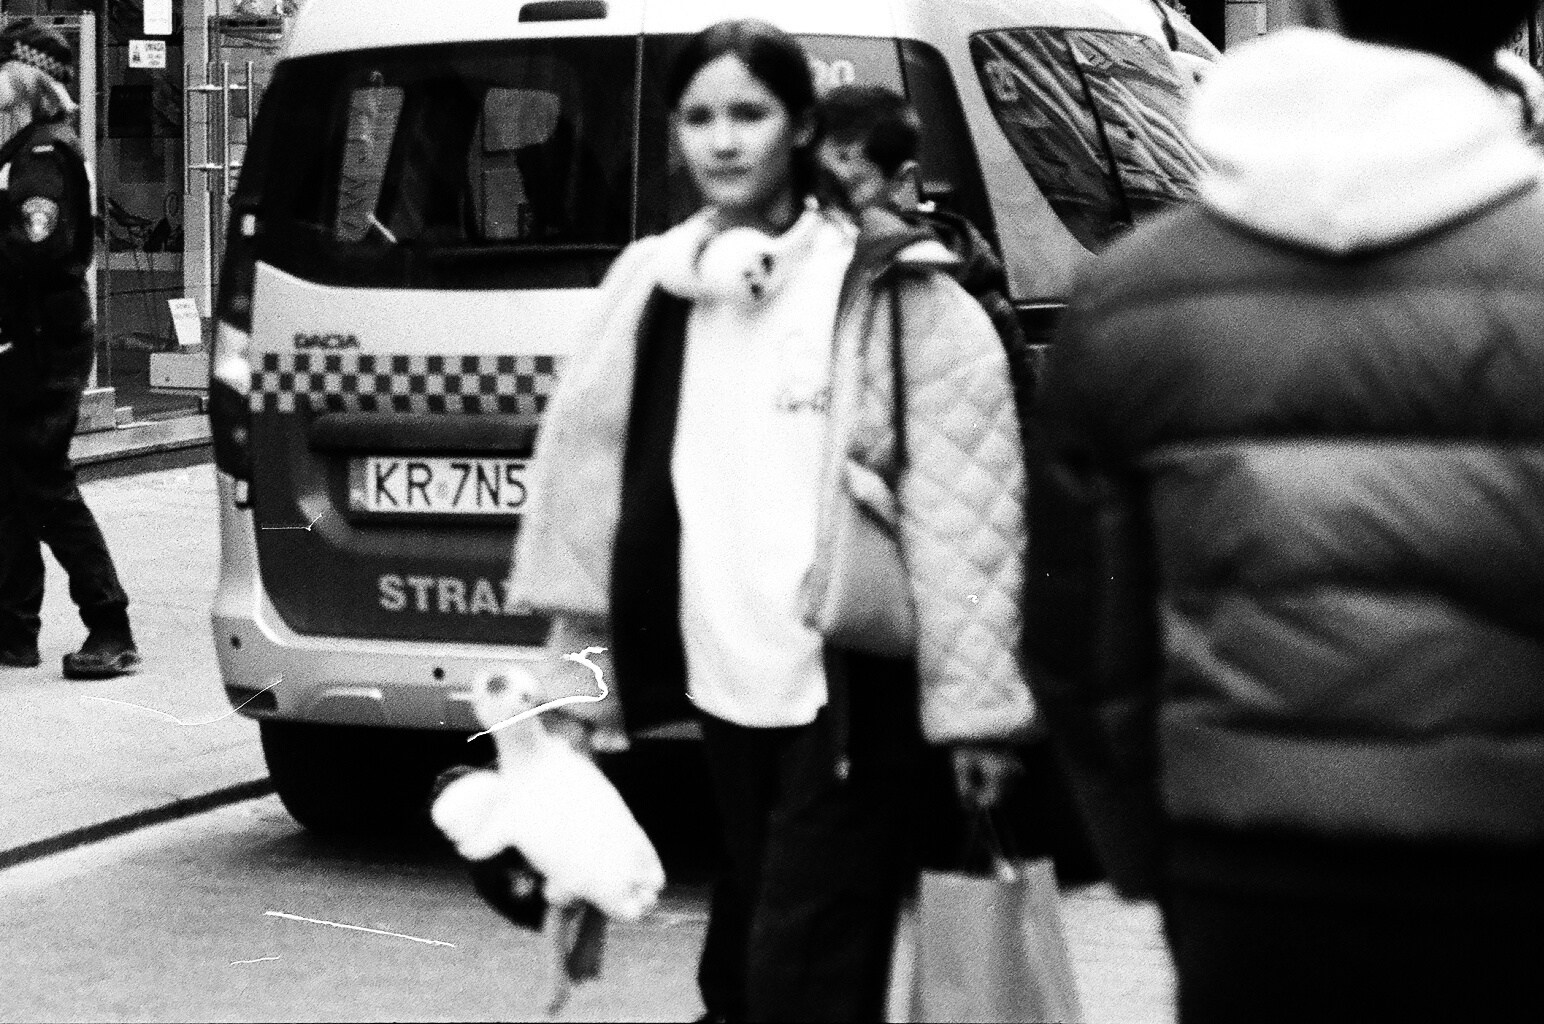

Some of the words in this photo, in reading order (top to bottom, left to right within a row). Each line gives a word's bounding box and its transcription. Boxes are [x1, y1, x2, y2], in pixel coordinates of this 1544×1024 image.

[294, 333, 360, 350] DACIA
[375, 462, 433, 507] KR
[451, 462, 528, 508] 7N5
